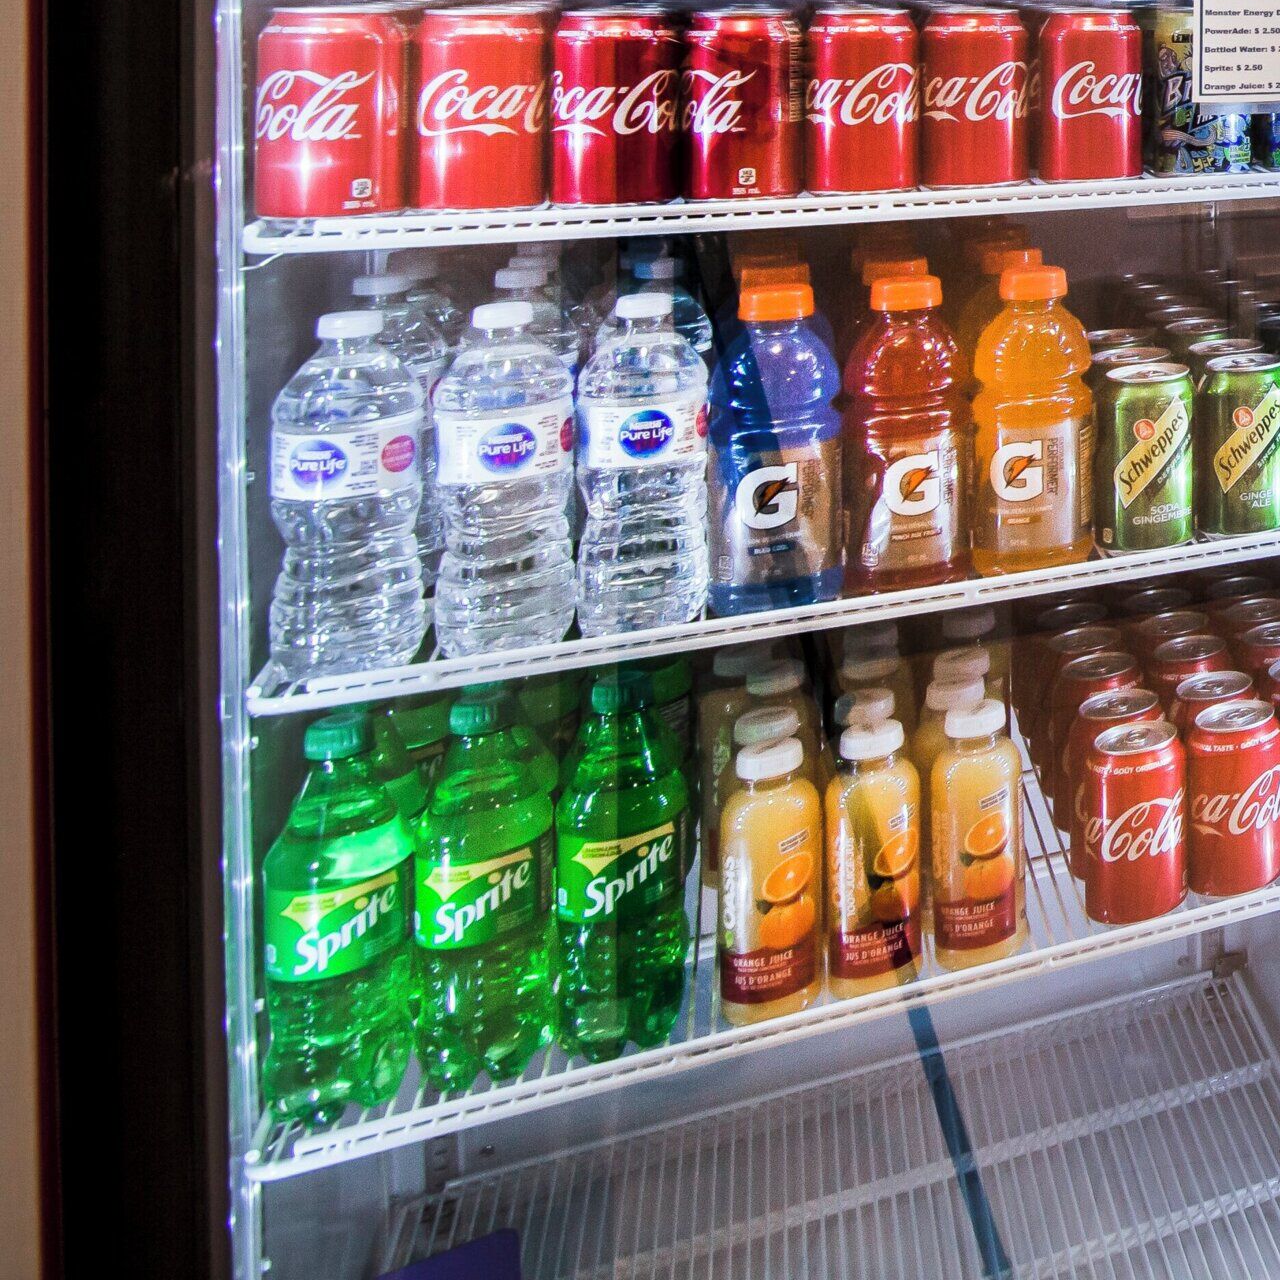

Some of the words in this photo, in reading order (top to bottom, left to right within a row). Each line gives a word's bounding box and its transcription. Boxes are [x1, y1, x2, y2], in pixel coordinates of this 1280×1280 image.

[1243, 9, 1274, 18] Energy
[1204, 27, 1252, 35] PowerAde:
[1254, 27, 1260, 35] $
[1262, 27, 1280, 35] 2.50
[1270, 45, 1276, 53] $
[1204, 65, 1234, 73] Sprite:
[1236, 64, 1242, 72] $
[1244, 64, 1263, 72] 2.50
[1203, 83, 1236, 92] Orange
[1267, 82, 1273, 90] $
[619, 429, 650, 442] Pure
[651, 426, 674, 443] Life
[478, 443, 511, 457] Pure
[511, 439, 536, 456] Life
[1119, 410, 1184, 496] Schweppes
[989, 438, 1044, 503] G
[1046, 437, 1059, 496] PERFORMER
[884, 450, 941, 517] G
[736, 461, 798, 530] G
[1251, 498, 1272, 509] ALE
[1150, 502, 1180, 516] SODA
[1212, 743, 1235, 753] TASTE
[583, 834, 673, 919] Sprite
[432, 861, 530, 945] Sprite
[972, 900, 995, 916] JUICE
[294, 884, 398, 976] Sprite
[843, 931, 879, 945] ORANGE
[881, 922, 904, 937] JUICE
[954, 918, 995, 934] D'ORANGE
[733, 956, 766, 968] ORANGE
[768, 949, 794, 965] JUICE
[861, 939, 903, 961] D'ORANGE
[748, 967, 793, 986] D'ORANGE
